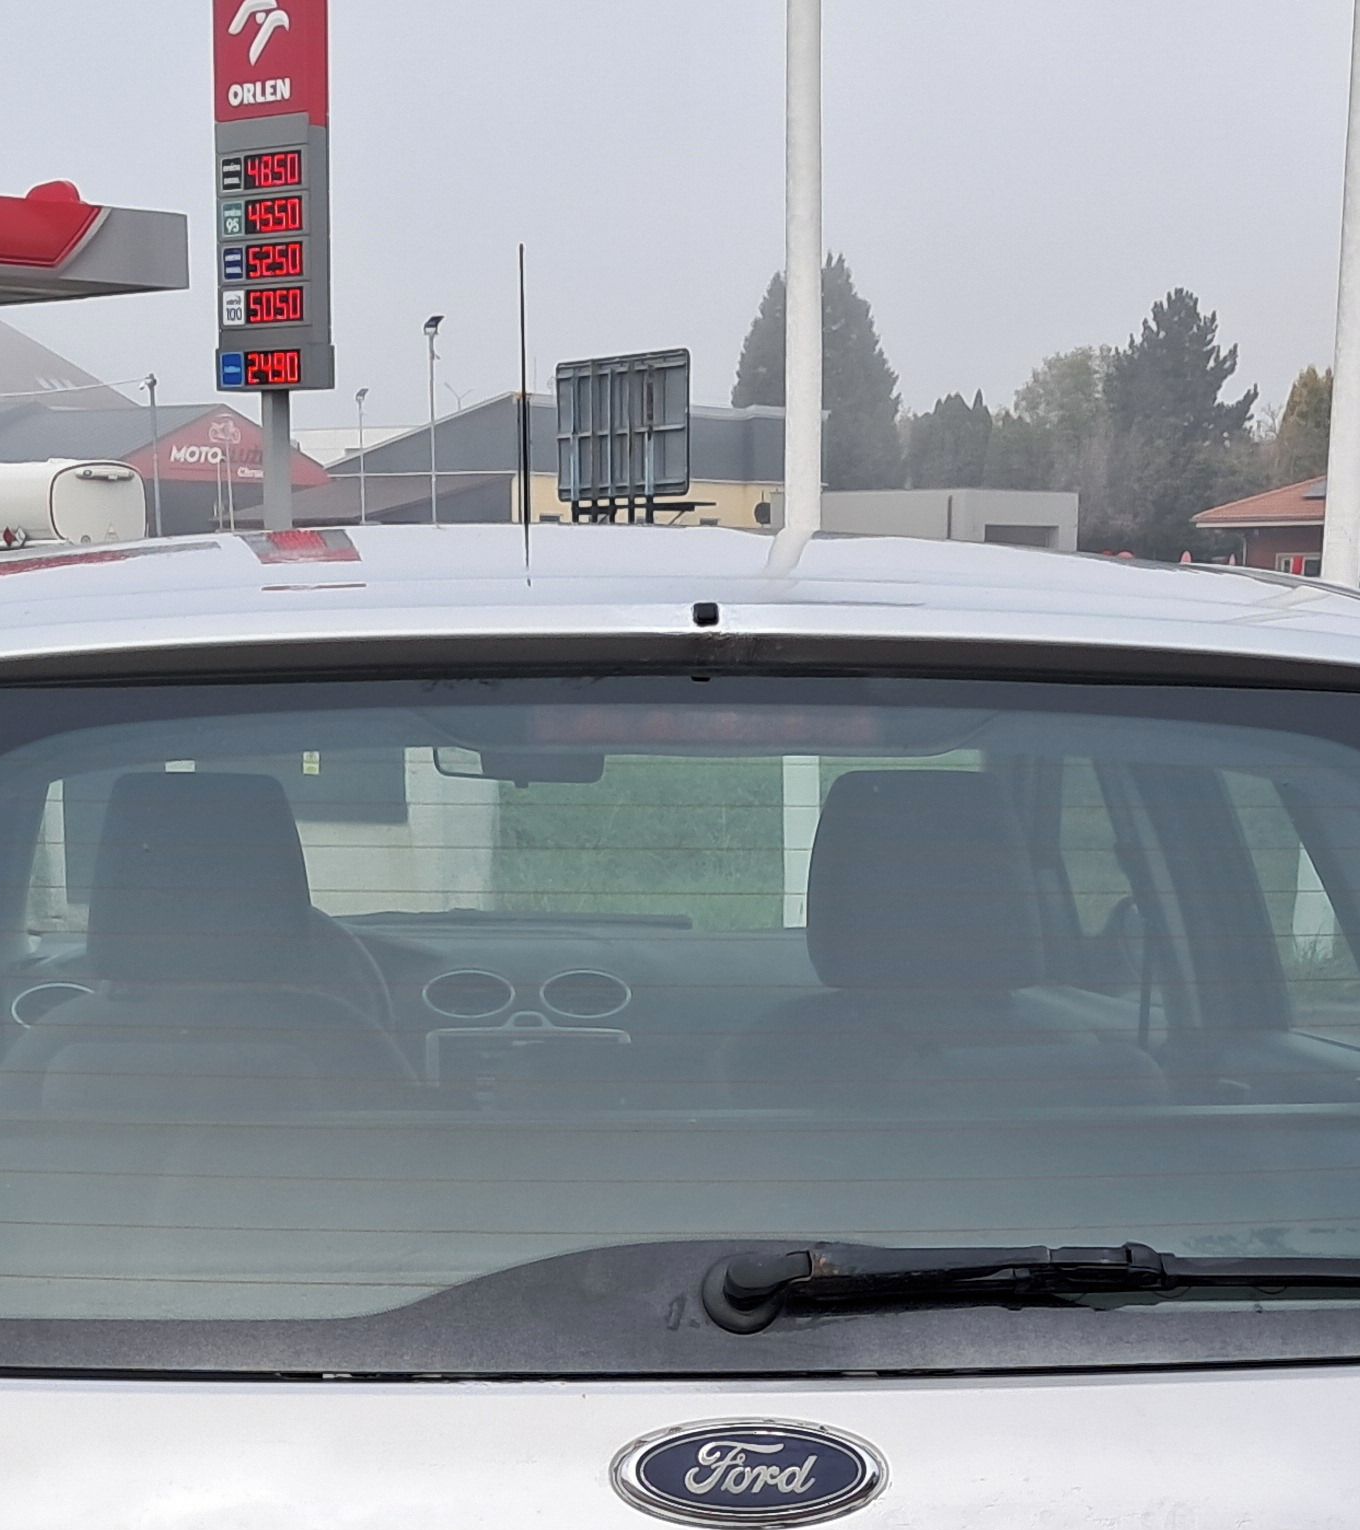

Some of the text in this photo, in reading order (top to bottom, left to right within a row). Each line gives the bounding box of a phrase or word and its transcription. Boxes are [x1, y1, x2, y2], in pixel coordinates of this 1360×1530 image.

[227, 77, 291, 107] ORLEN
[247, 153, 299, 187] 4850
[225, 217, 240, 233] 95
[247, 198, 300, 232] 4550
[248, 243, 301, 278] 5250
[226, 306, 243, 321] 100
[249, 288, 301, 323] 5050
[247, 352, 299, 385] 2490
[169, 444, 223, 464] MOTO
[684, 1440, 818, 1495] Ford
